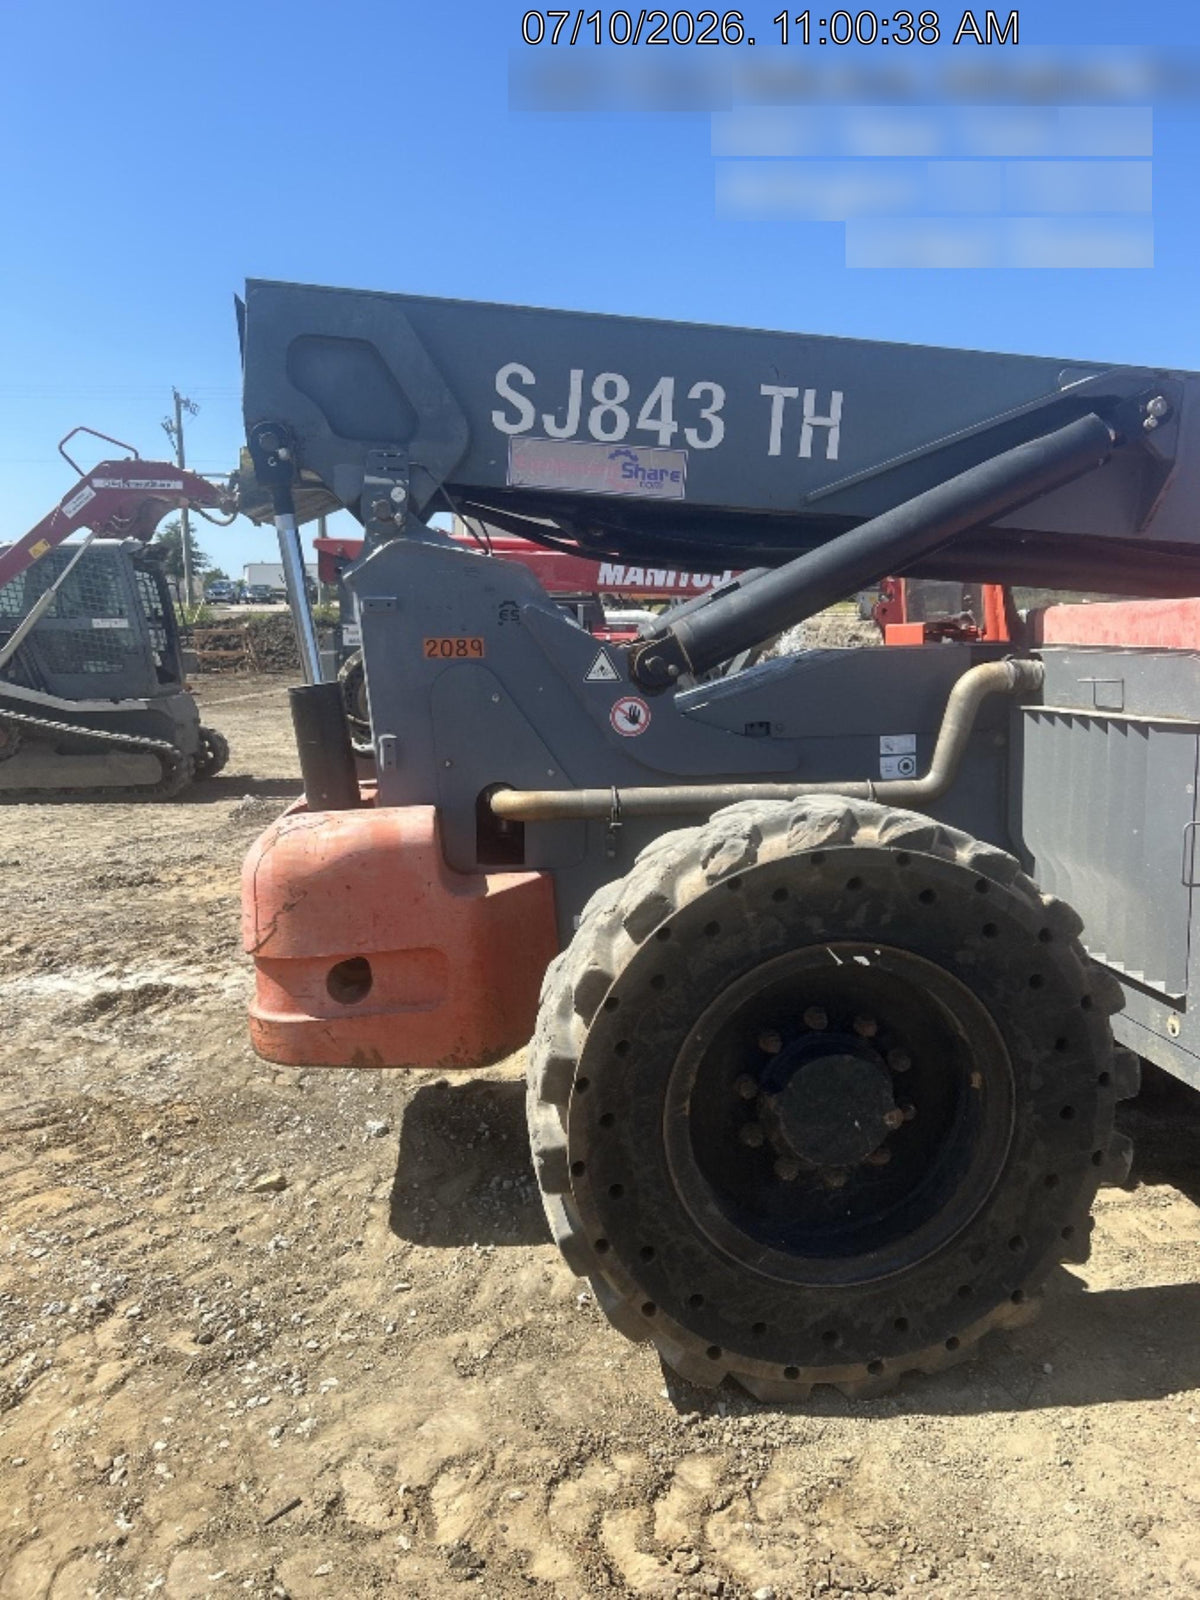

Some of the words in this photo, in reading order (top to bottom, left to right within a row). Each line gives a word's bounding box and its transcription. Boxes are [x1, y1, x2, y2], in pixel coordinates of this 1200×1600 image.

[491, 362, 726, 449] SJ843
[760, 384, 844, 460] TH
[621, 462, 681, 483] Share
[425, 639, 483, 657] 2089
